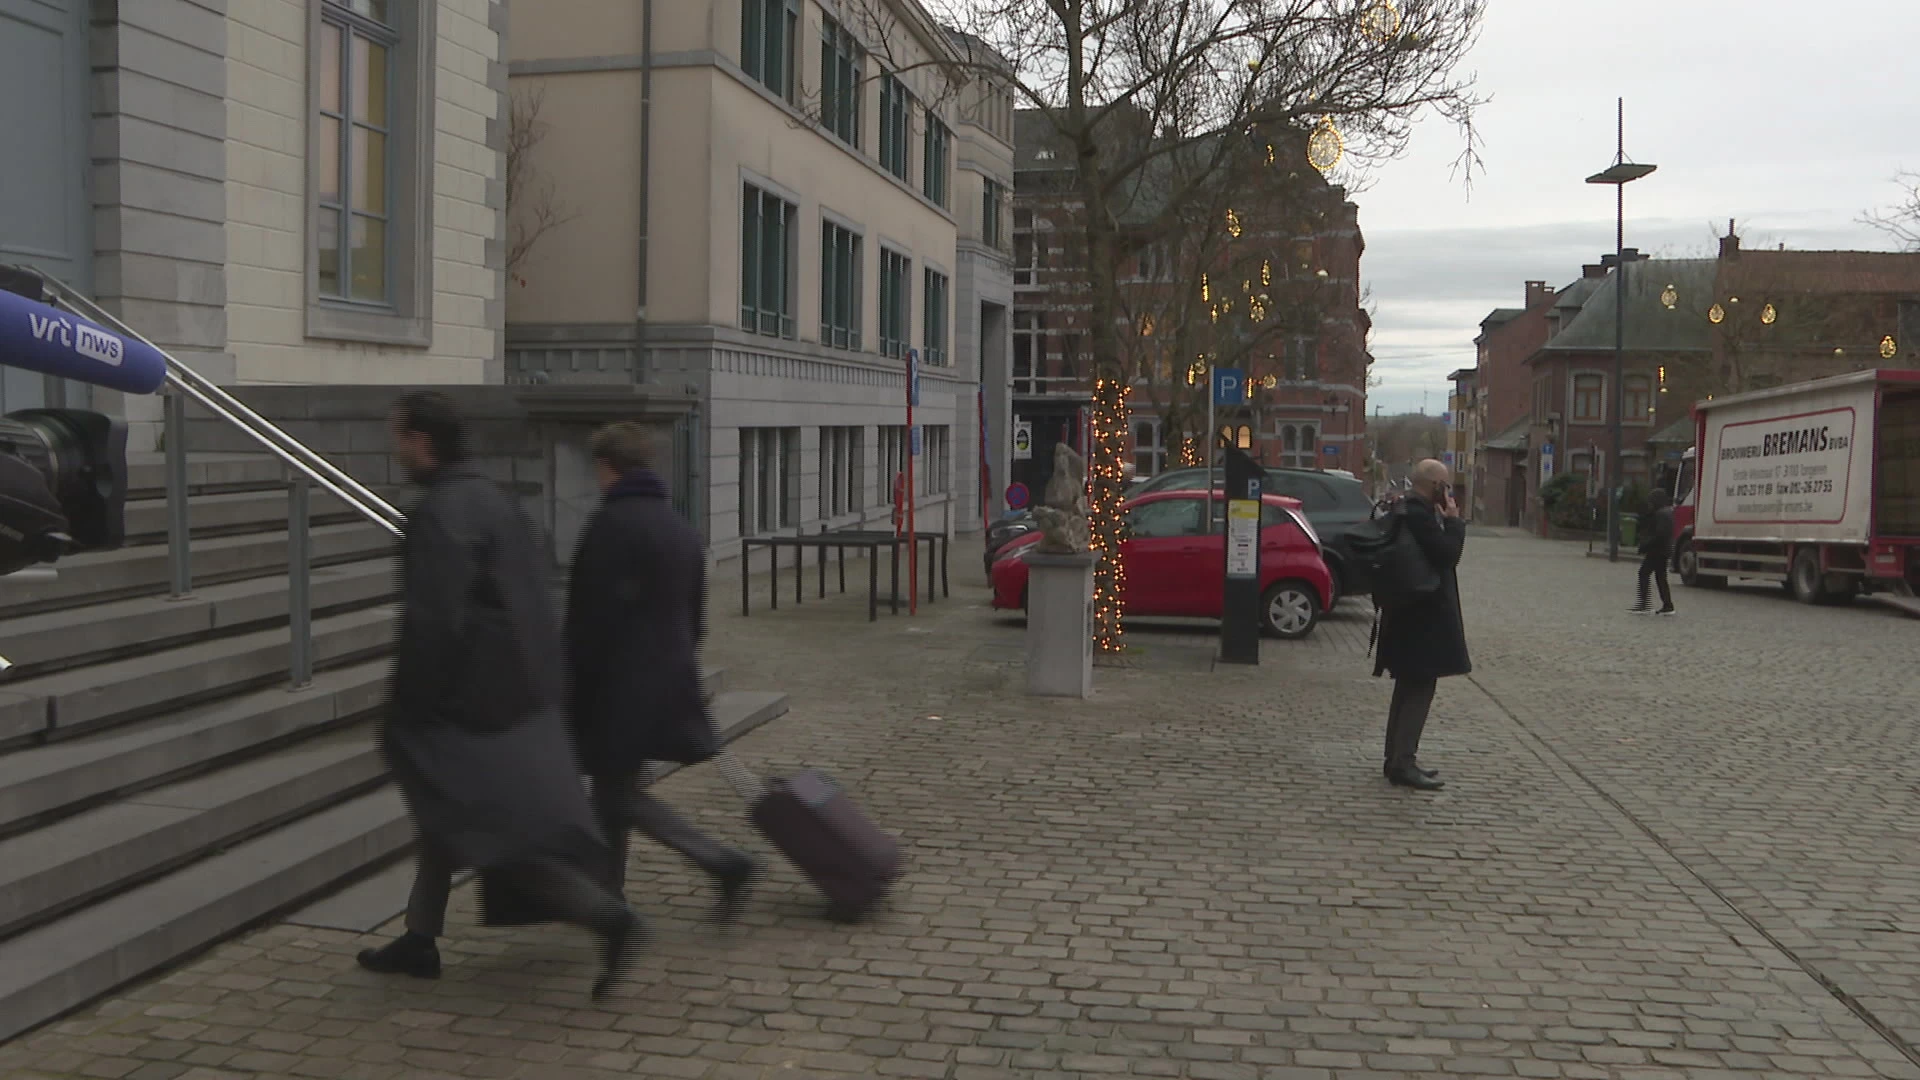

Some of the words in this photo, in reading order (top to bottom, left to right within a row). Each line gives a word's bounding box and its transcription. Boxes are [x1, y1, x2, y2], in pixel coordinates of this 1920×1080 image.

[28, 313, 72, 347] vrt
[82, 331, 119, 358] nws
[1220, 375, 1237, 398] P
[1763, 426, 1829, 456] BREMANS
[1249, 479, 1260, 498] P
